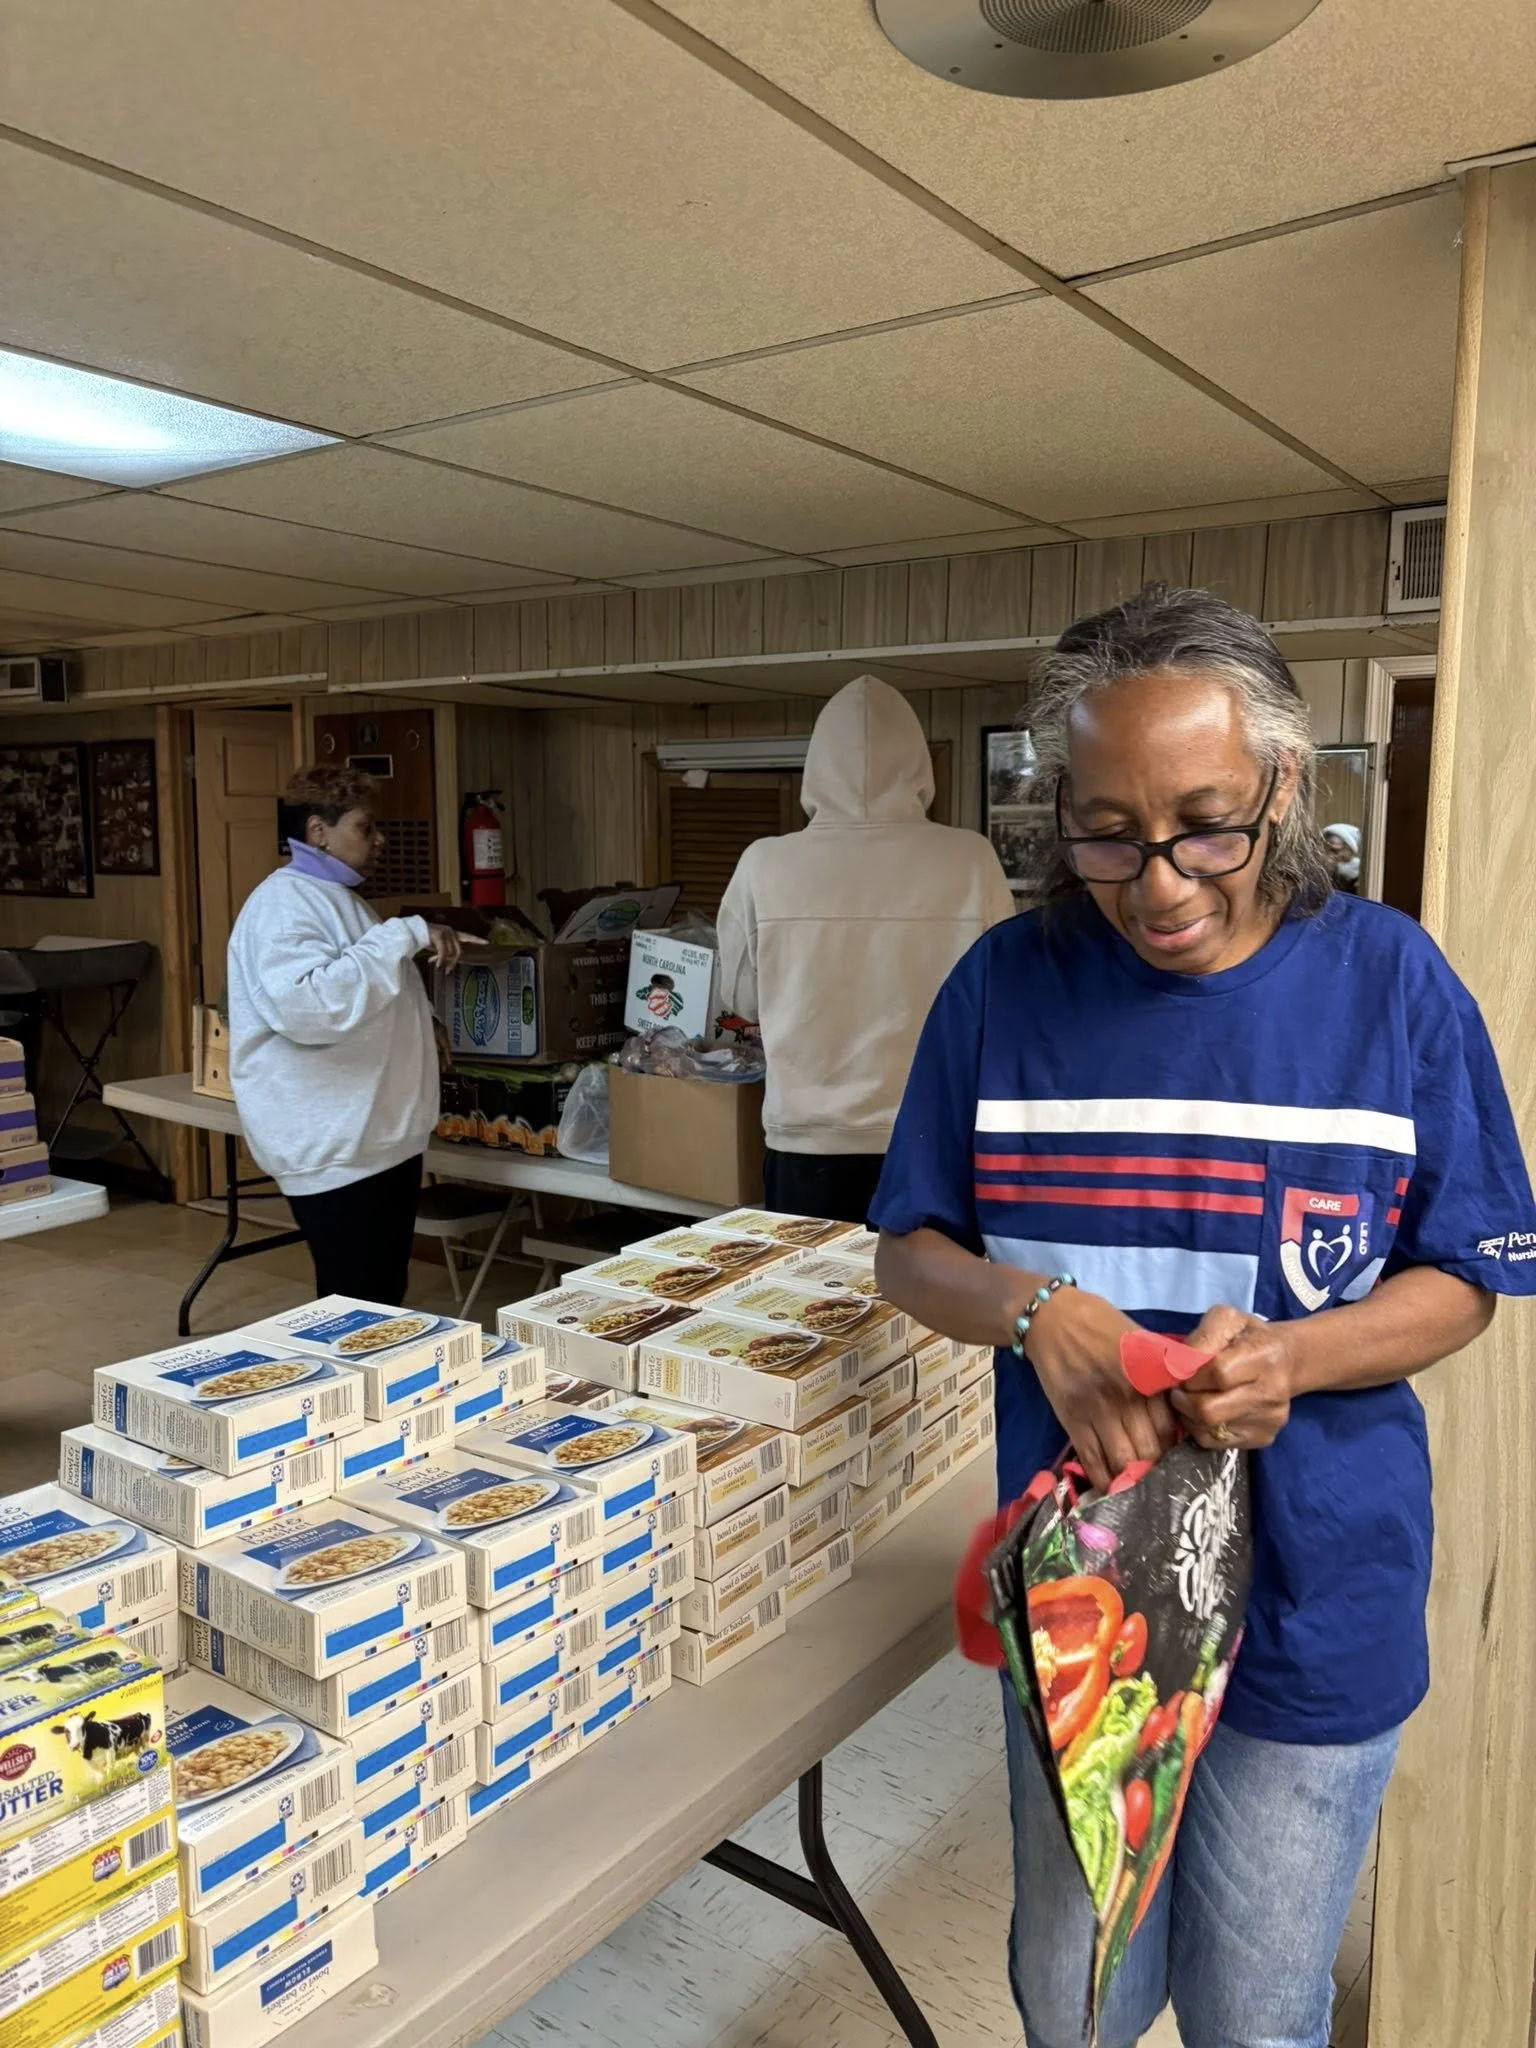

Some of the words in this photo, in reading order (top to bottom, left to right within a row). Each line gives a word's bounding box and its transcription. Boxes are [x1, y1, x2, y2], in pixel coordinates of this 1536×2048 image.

[642, 953, 658, 968] NORTH
[659, 958, 686, 975] CAROLINA
[1309, 1197, 1342, 1212] CARE
[1359, 1222, 1369, 1256] LEAD
[1284, 1256, 1317, 1305] INNOVATE
[107, 1386, 115, 1424] basket
[528, 1422, 561, 1437] ELBOW
[807, 1435, 820, 1449] bowl
[825, 1423, 843, 1438] basket
[66, 1457, 74, 1486] bowl
[73, 1449, 81, 1488] basket
[711, 1472, 727, 1487] bowl
[733, 1459, 754, 1473] basket
[423, 1477, 462, 1494] ELBOW
[0, 1521, 34, 1537] BOW
[273, 1529, 319, 1548] ELBOW
[716, 1527, 732, 1541] bowl
[738, 1512, 758, 1528] basket
[720, 1581, 735, 1595] bowl
[740, 1563, 760, 1580] basket
[803, 1560, 823, 1577] basket
[729, 1614, 752, 1632] basket
[0, 1771, 56, 1803] SALTED
[23, 1980, 39, 1995] 100
[284, 1966, 311, 1989] ELBOW
[309, 1967, 330, 1987] bowl
[265, 1988, 298, 2015] basket
